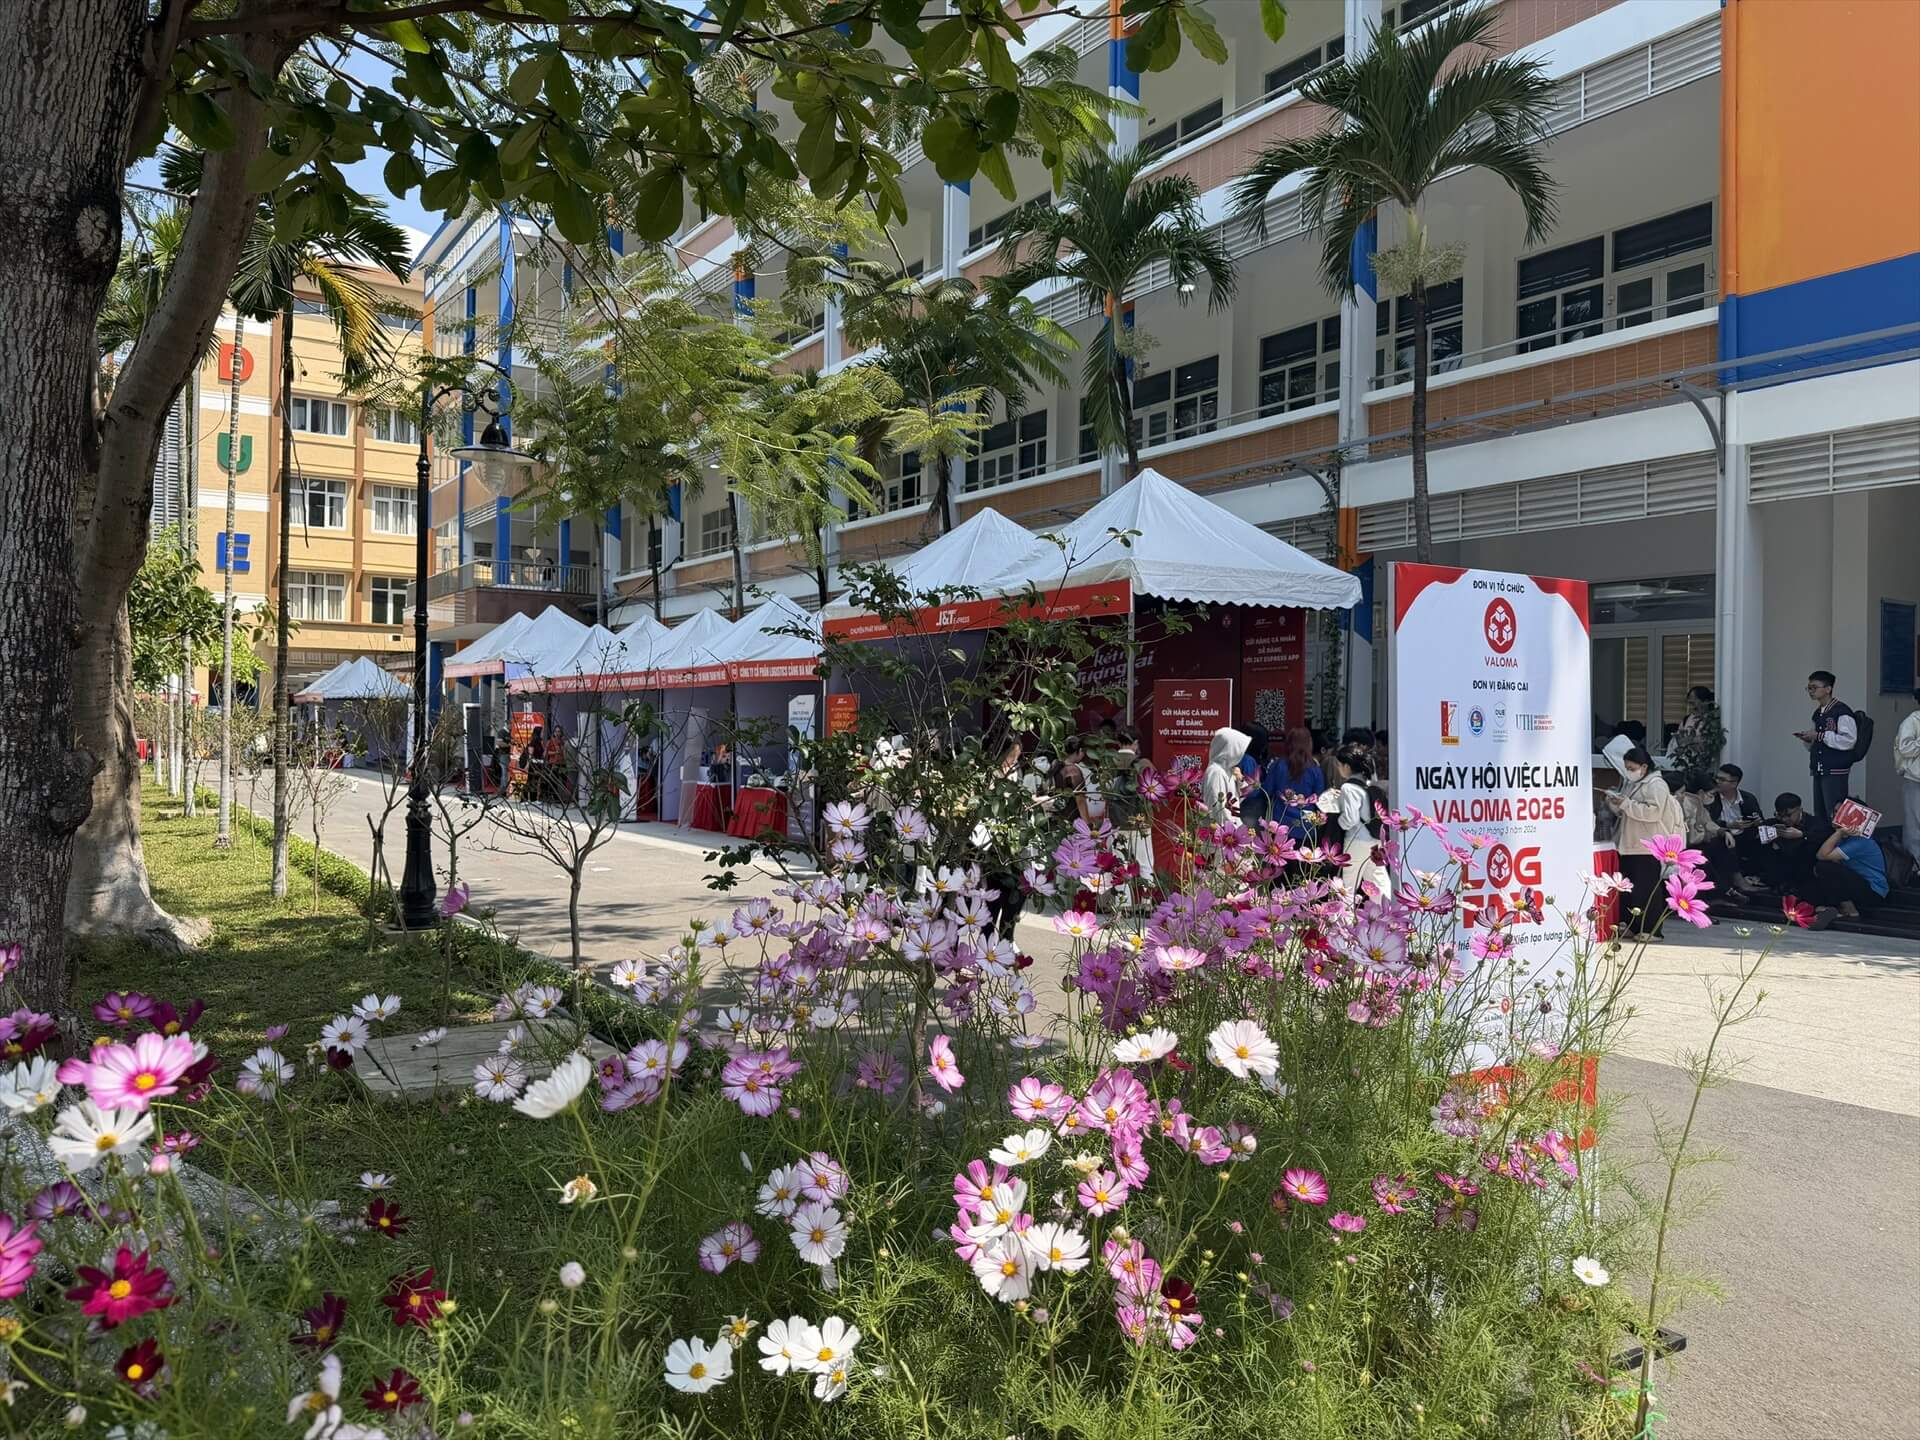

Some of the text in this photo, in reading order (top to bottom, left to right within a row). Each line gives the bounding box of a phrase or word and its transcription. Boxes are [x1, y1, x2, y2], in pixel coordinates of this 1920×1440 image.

[1473, 579, 1525, 593] ĐƠN VỊ TỔ CHỨC
[936, 610, 957, 626] J&T
[1485, 656, 1518, 668] VALOMA
[1472, 680, 1528, 692] ĐƠN VỊ ĐĂNG CAI
[1173, 707, 1190, 716] HÀNG
[1191, 708, 1200, 716] CÁ
[1201, 708, 1219, 716] NHÂN
[1415, 761, 1579, 793] NGÀY HỘI VIỆC LÀM
[1433, 797, 1565, 824] VALOMA 2026
[1530, 933, 1541, 945] tạo
